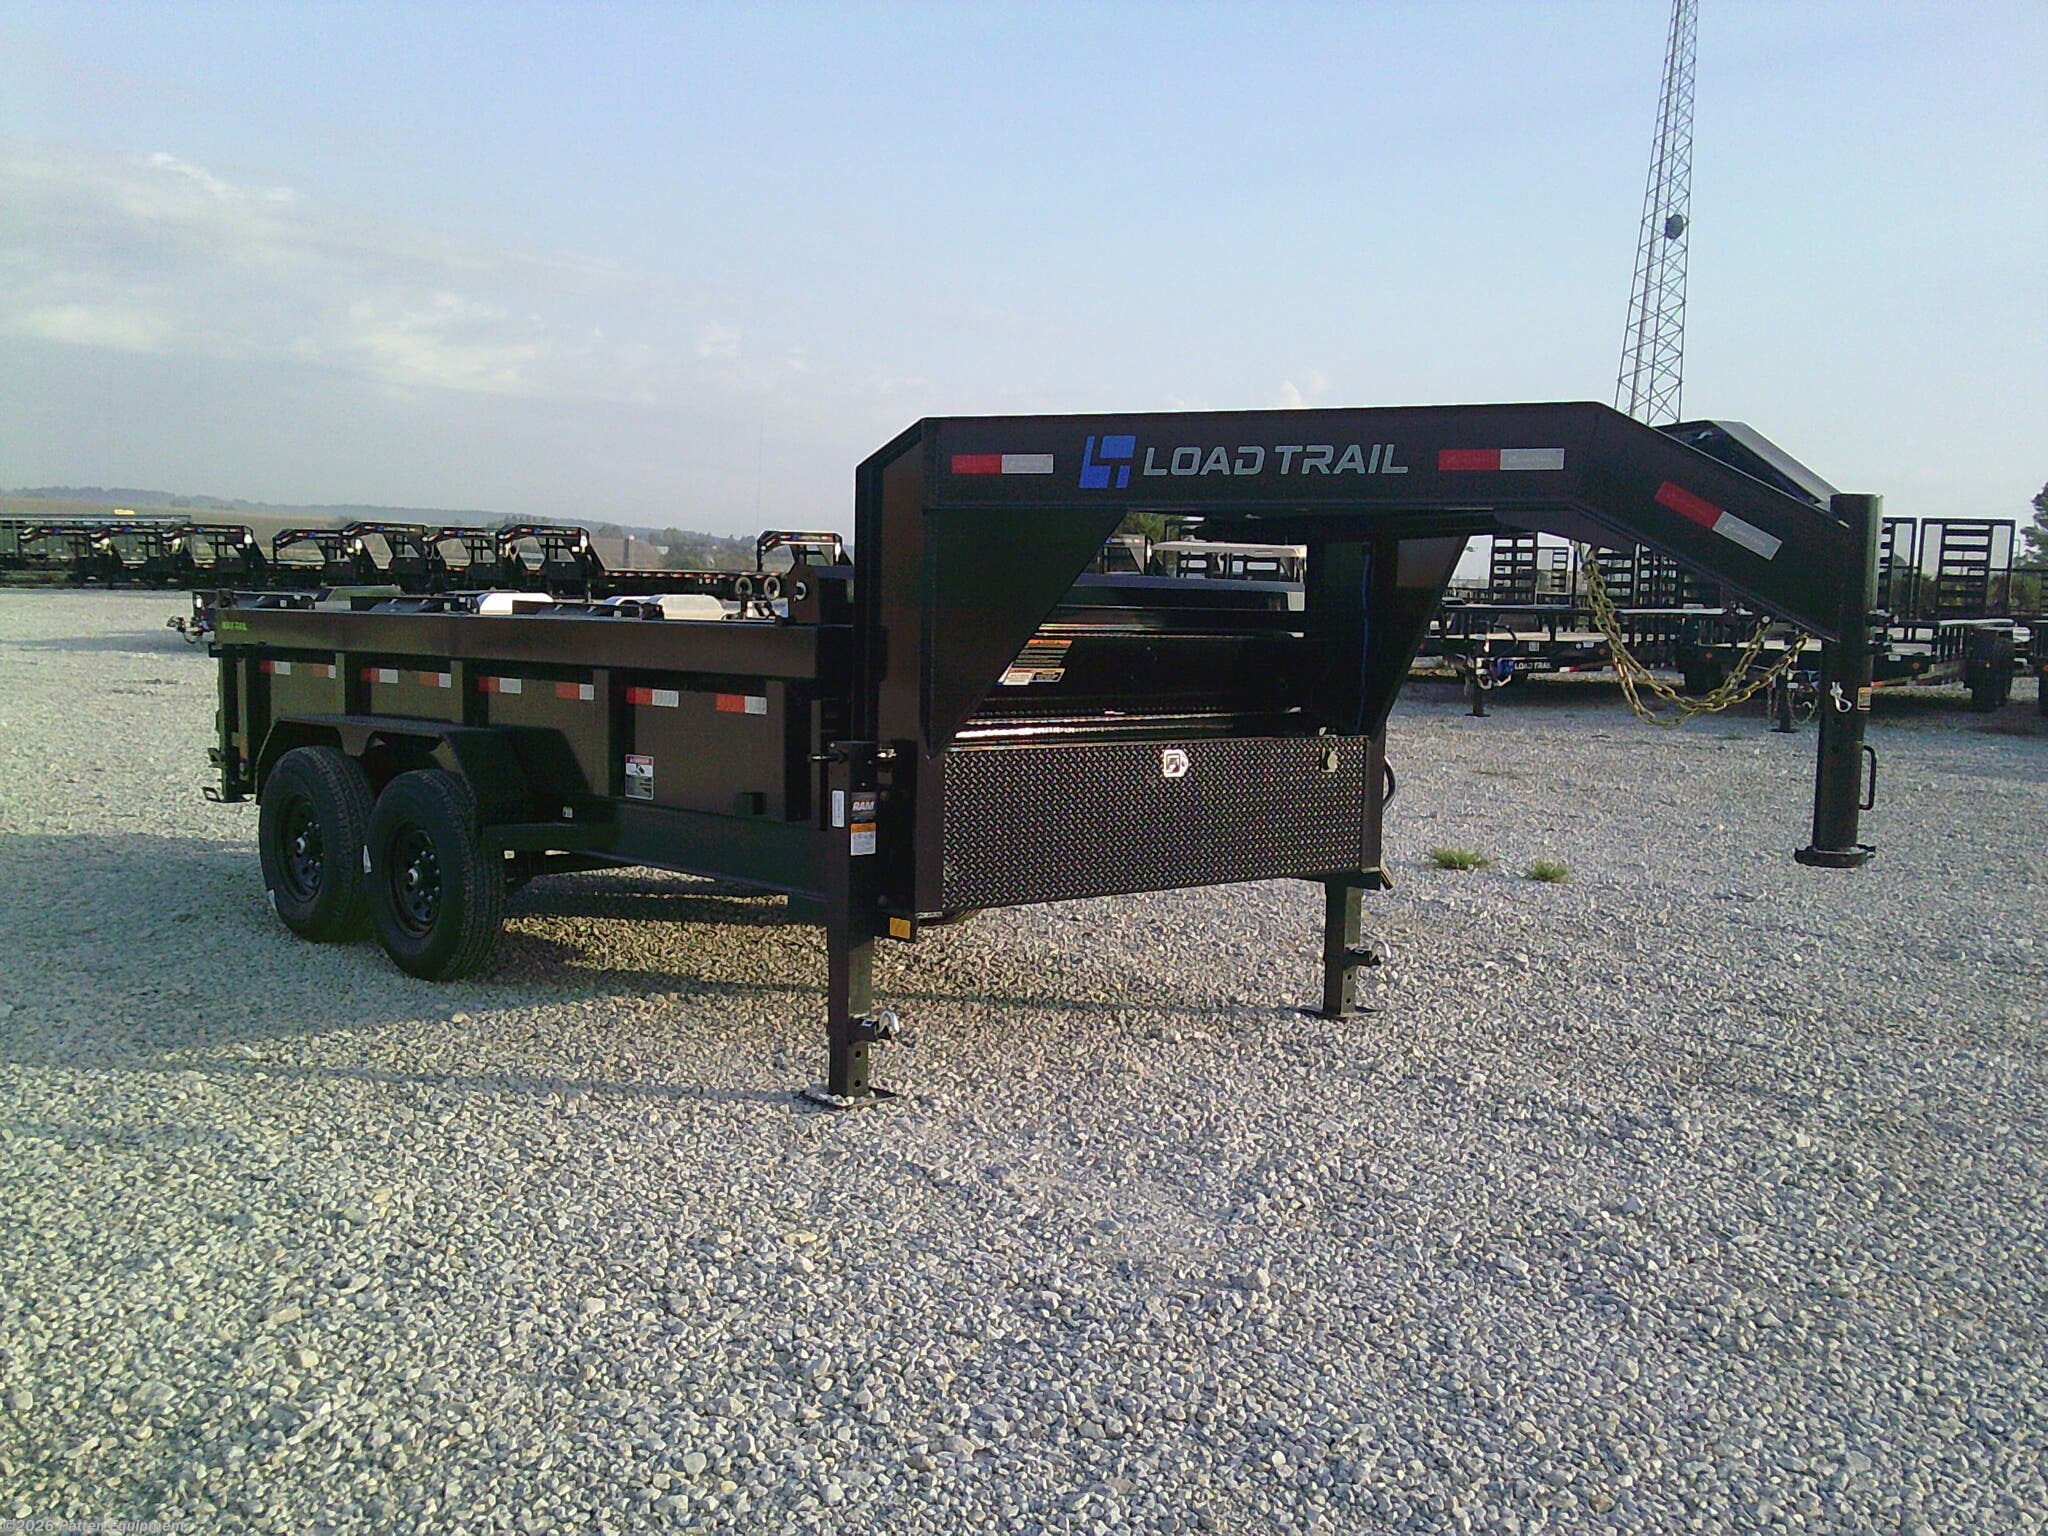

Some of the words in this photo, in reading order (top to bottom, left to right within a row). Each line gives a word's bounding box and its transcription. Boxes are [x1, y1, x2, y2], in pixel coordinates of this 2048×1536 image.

[1143, 446, 1266, 476] LOAD
[1275, 443, 1409, 475] TRAIL
[852, 801, 875, 812] RAM
